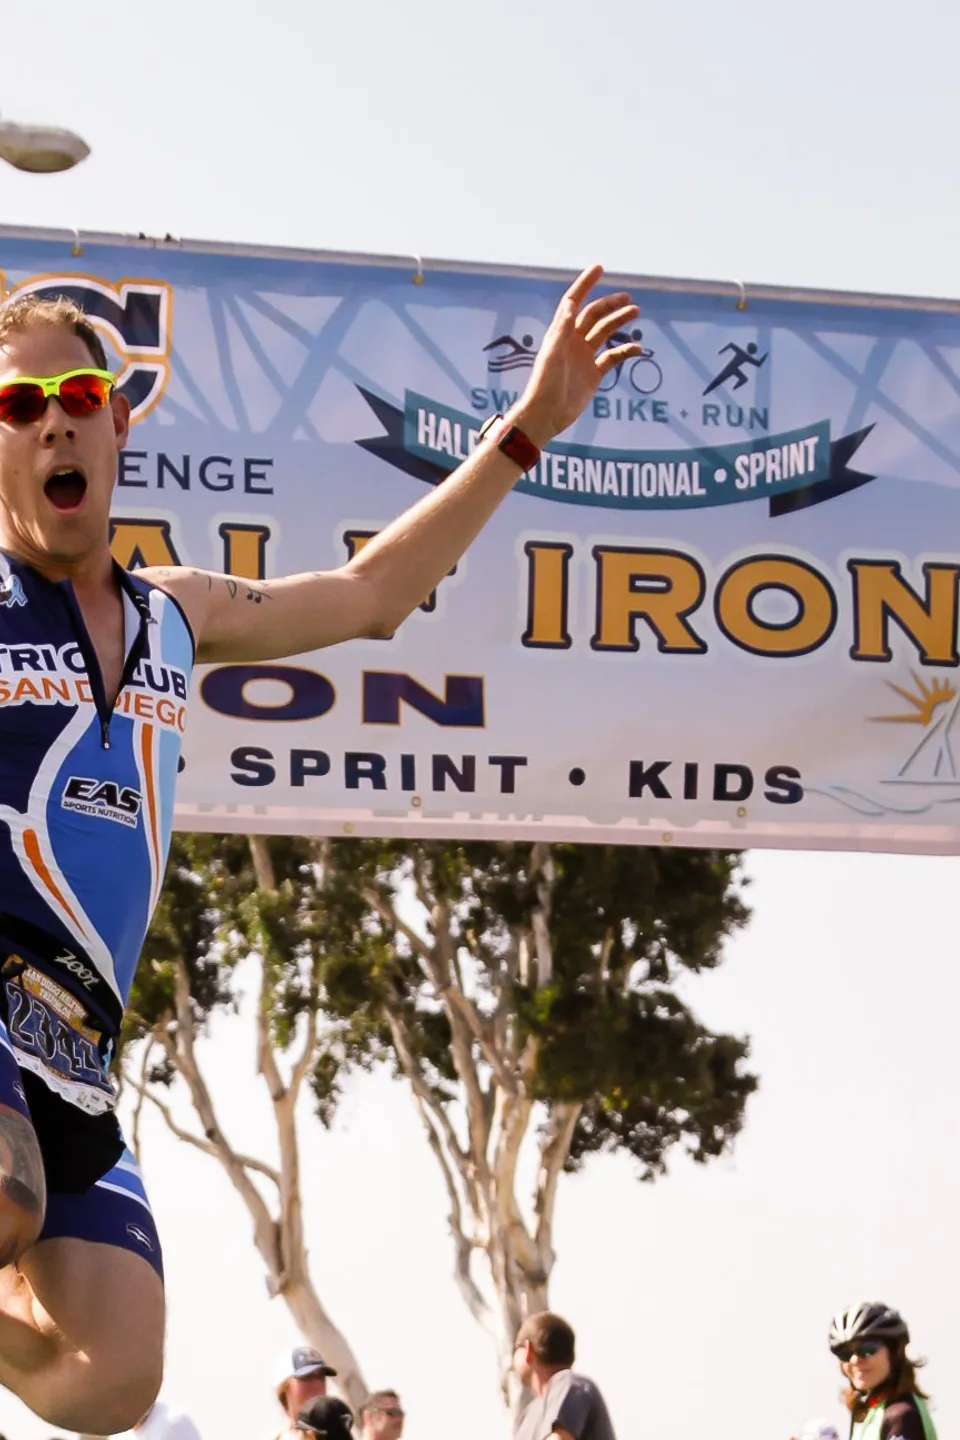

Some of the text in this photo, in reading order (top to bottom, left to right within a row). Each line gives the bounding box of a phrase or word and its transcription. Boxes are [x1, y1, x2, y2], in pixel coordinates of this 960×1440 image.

[471, 388, 769, 430] SW BIKE RUN
[734, 436, 819, 491] SPRINT
[522, 540, 960, 668] IRON
[64, 778, 144, 814] EAS
[230, 746, 804, 805] SPRINT KIDS
[64, 801, 137, 826] SPORTS NUTRITION
